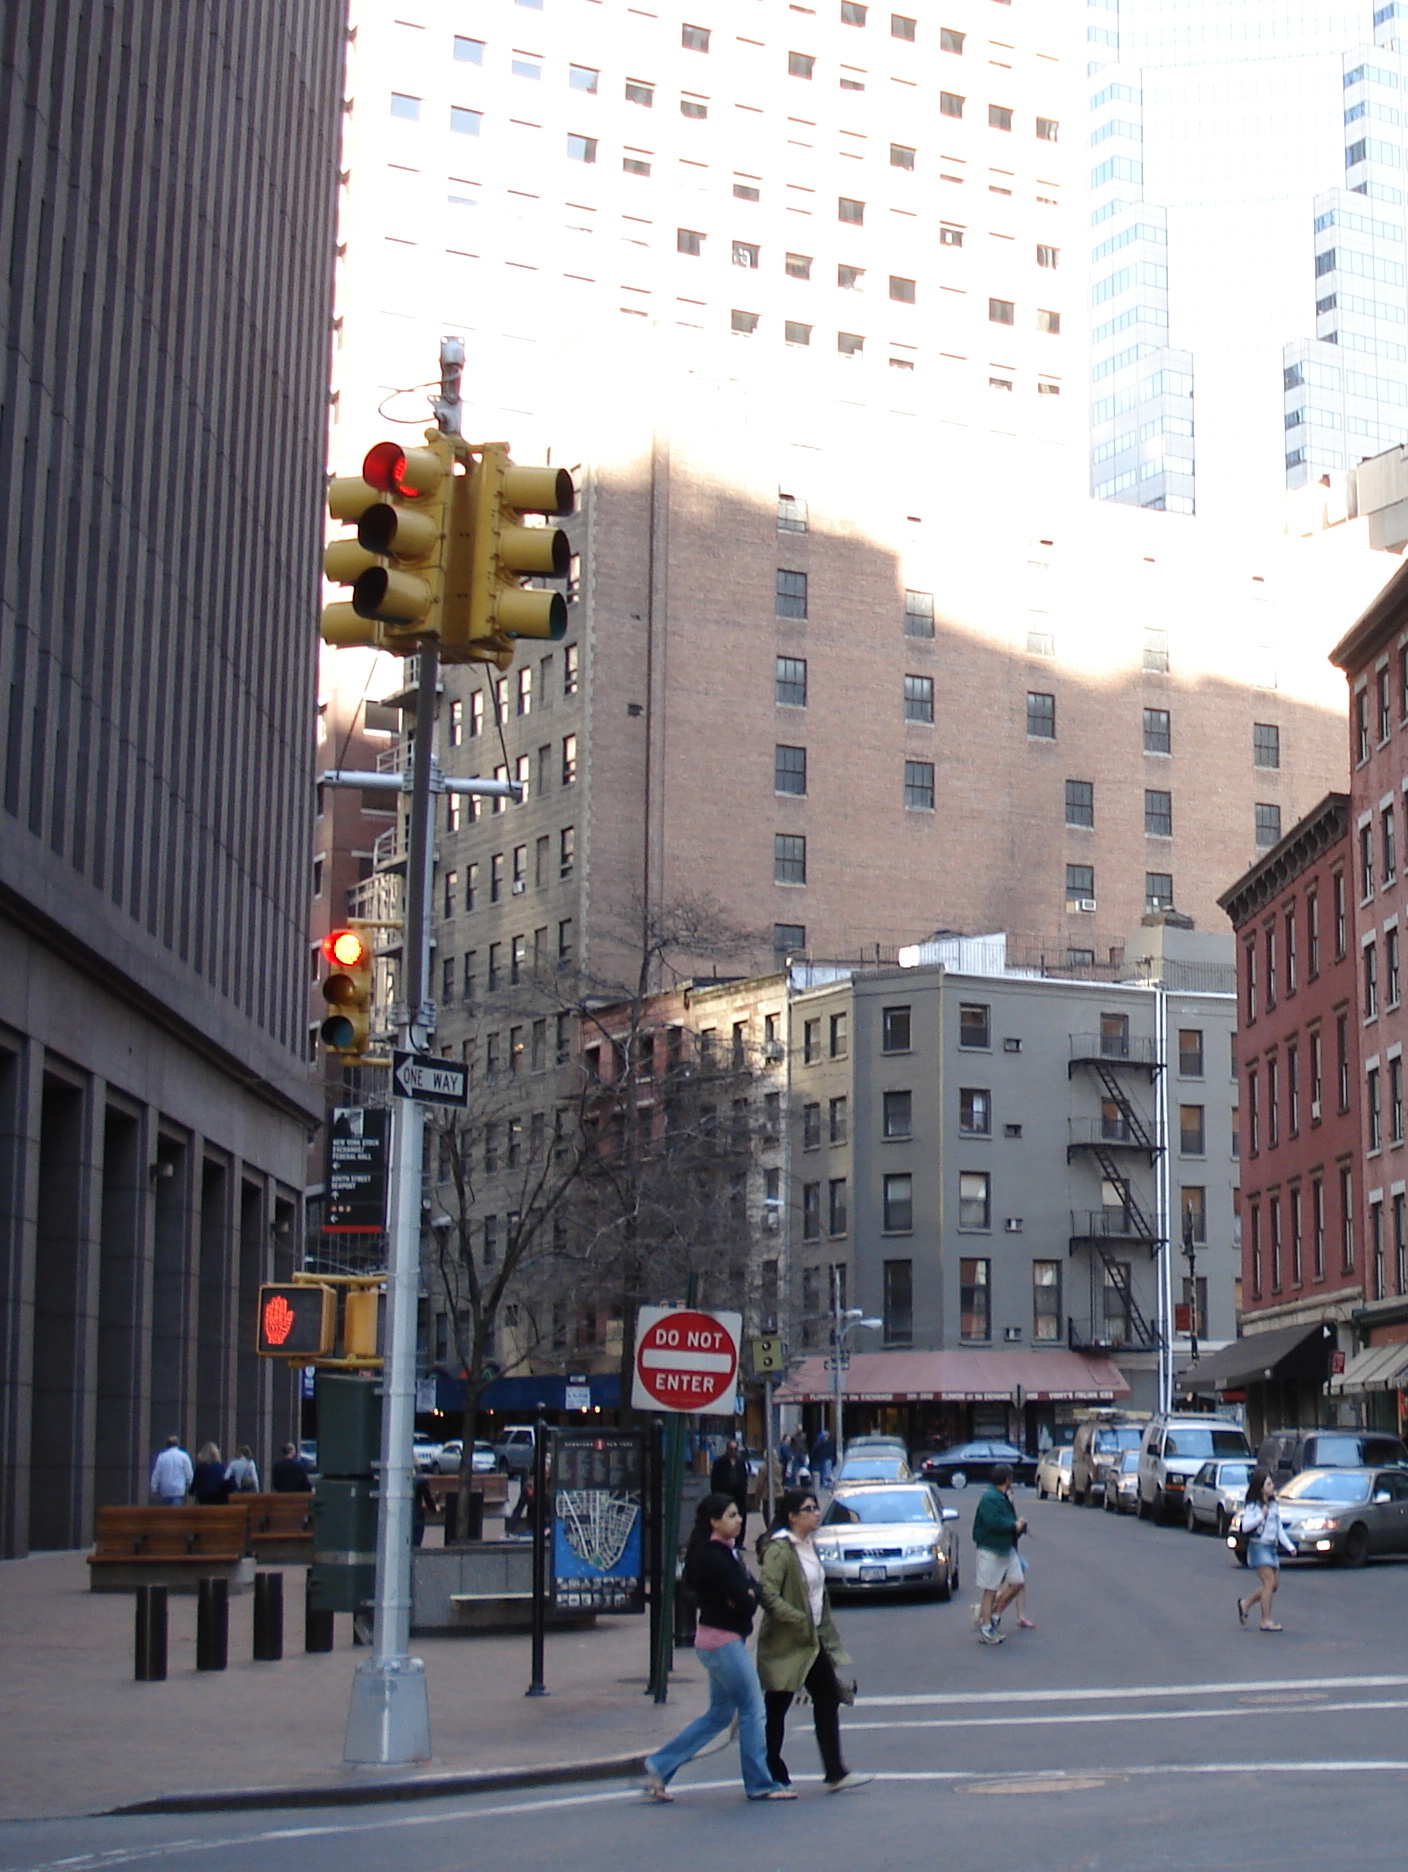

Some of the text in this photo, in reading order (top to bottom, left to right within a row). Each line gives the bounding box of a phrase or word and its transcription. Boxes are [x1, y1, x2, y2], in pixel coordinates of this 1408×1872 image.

[403, 1066, 459, 1093] ONE WAY
[655, 1328, 723, 1349] DO NOT
[655, 1373, 715, 1394] ENTER
